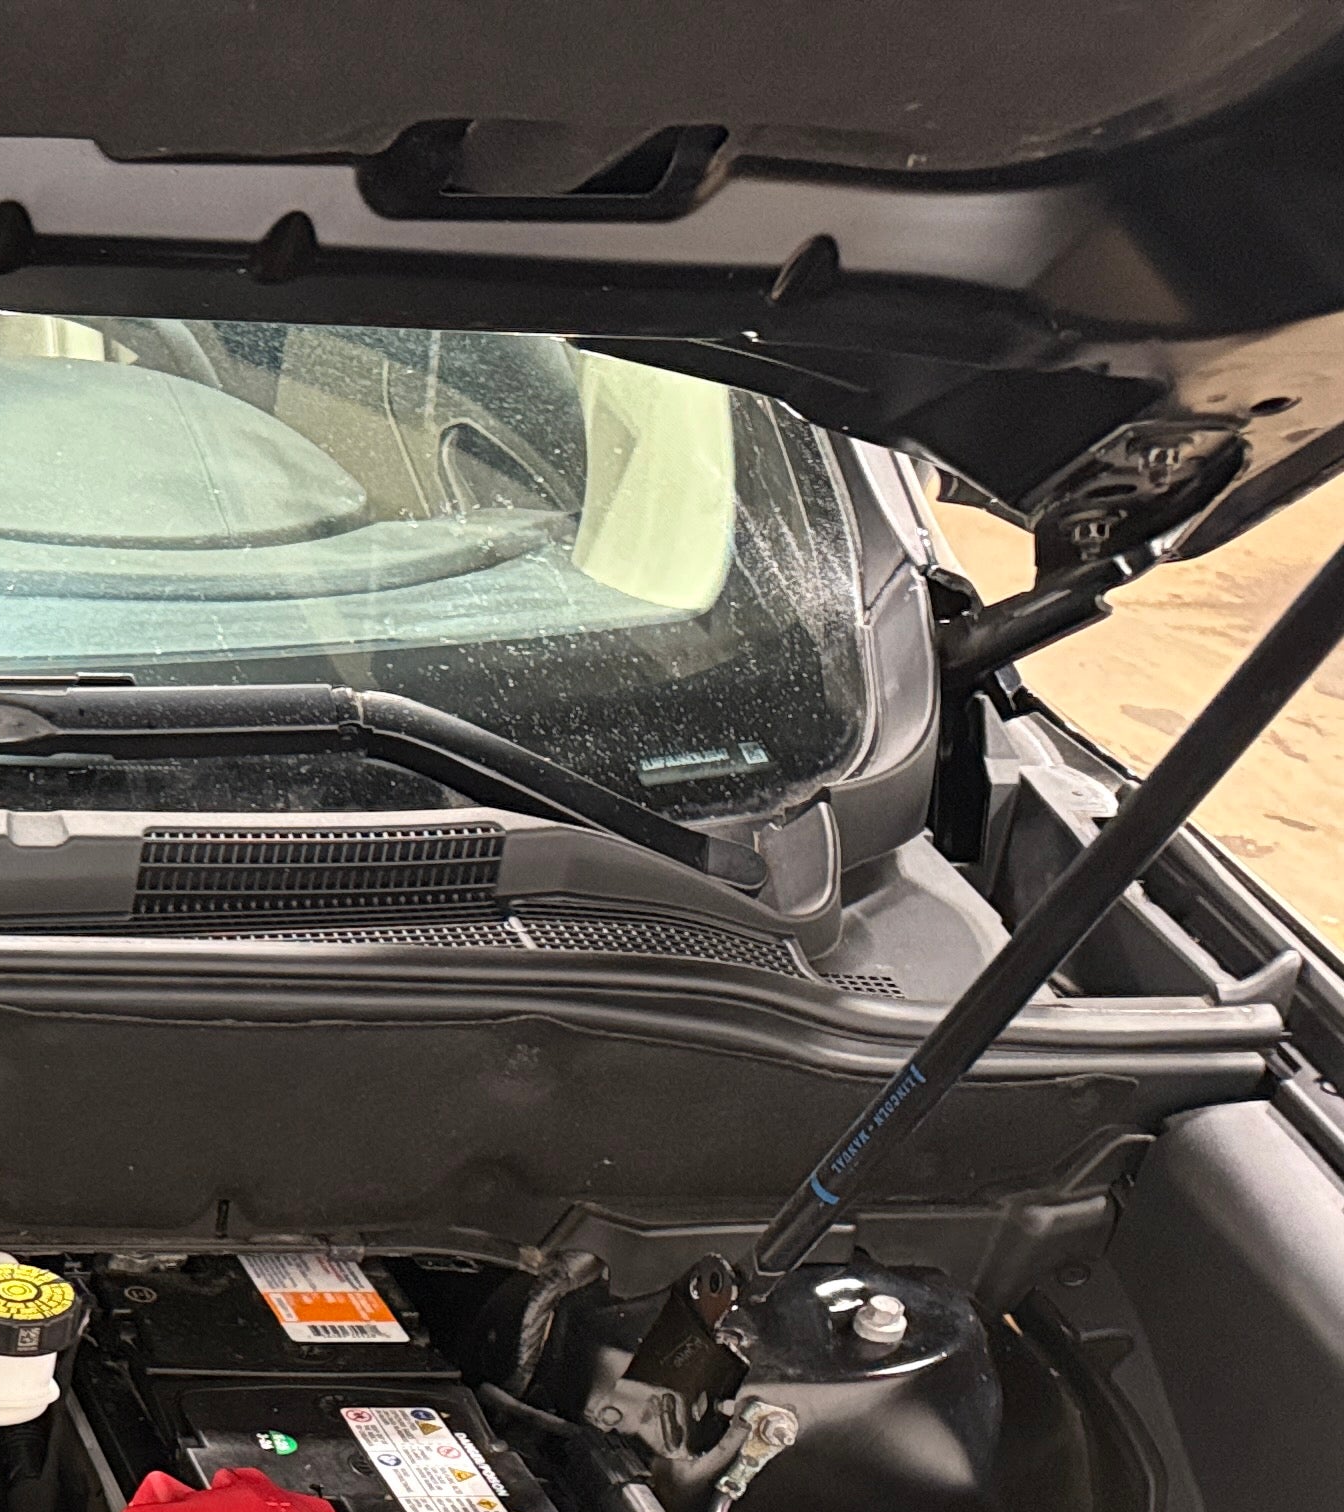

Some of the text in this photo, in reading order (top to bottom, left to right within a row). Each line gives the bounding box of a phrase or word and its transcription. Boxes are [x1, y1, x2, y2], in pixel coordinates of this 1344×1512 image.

[873, 1077, 916, 1127] LINCOLN
[831, 1130, 871, 1174] MANUAL
[453, 1431, 511, 1498] DANGER/POISON
